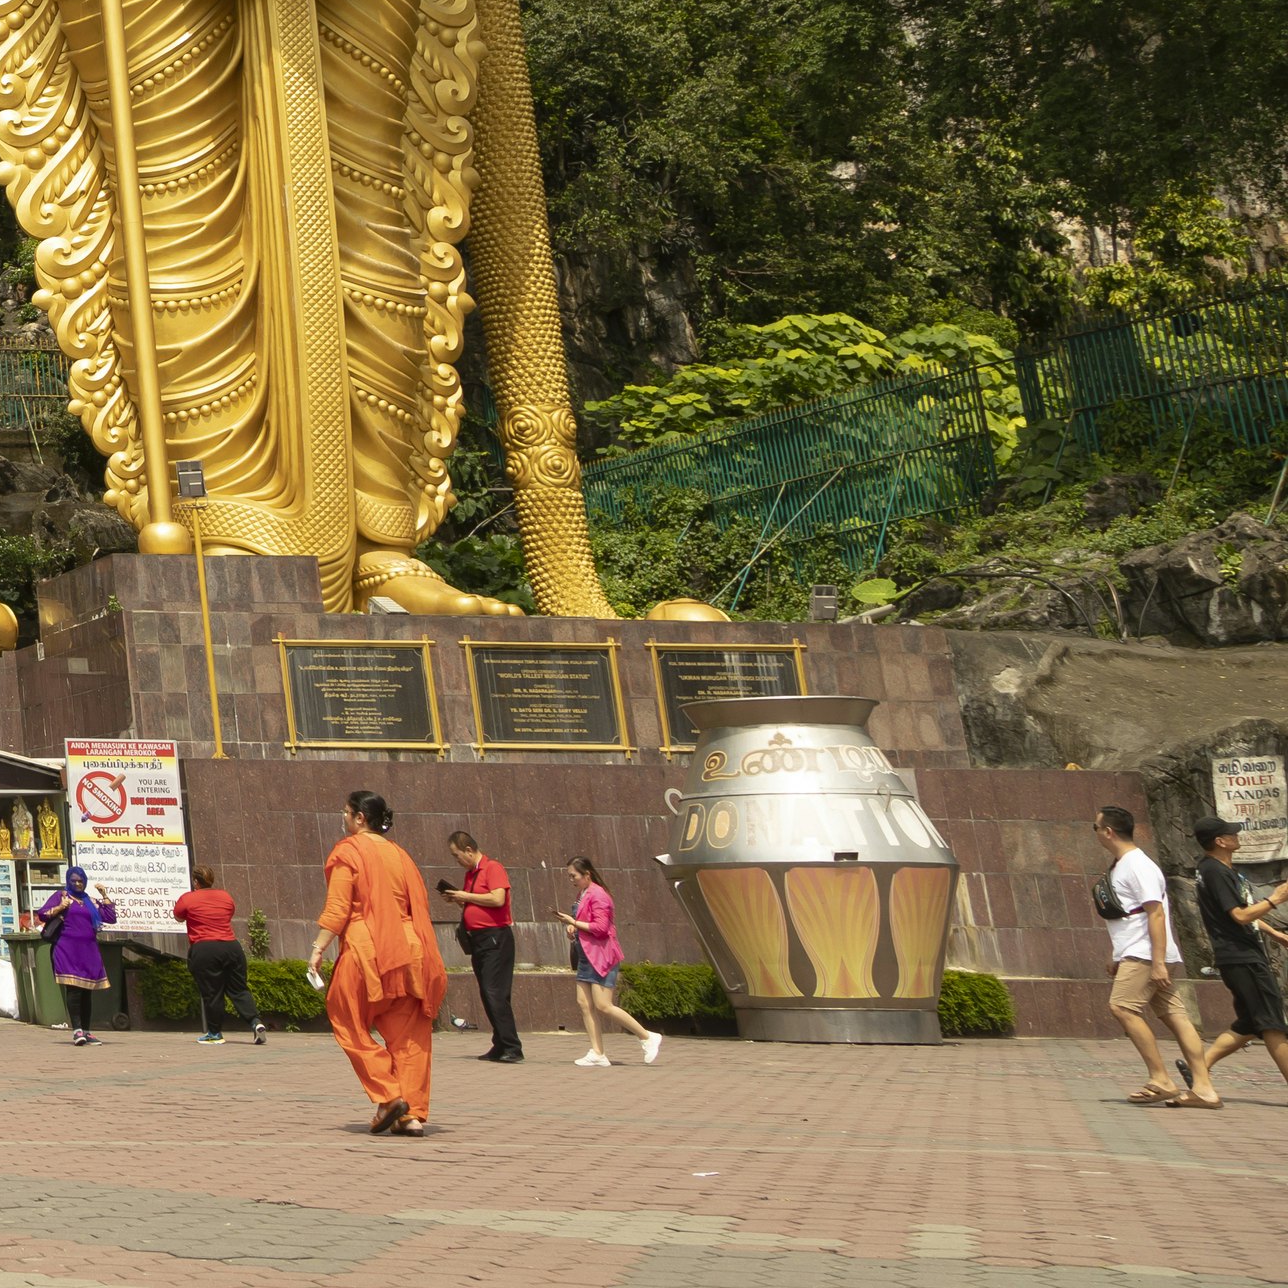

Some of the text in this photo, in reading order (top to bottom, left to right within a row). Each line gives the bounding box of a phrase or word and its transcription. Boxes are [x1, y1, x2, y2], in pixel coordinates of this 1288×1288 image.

[91, 742, 127, 750] MEMASUKI
[1225, 775, 1274, 786] TOILET
[137, 786, 171, 794] ENTERING
[1223, 787, 1280, 800] TANDAS
[81, 777, 123, 815] NO SMOKING
[135, 823, 165, 838] निषेध
[91, 861, 109, 872] 6.30
[147, 861, 167, 873] 8.30
[105, 886, 170, 896] TAIRCASE GATE
[128, 899, 163, 907] OPENING
